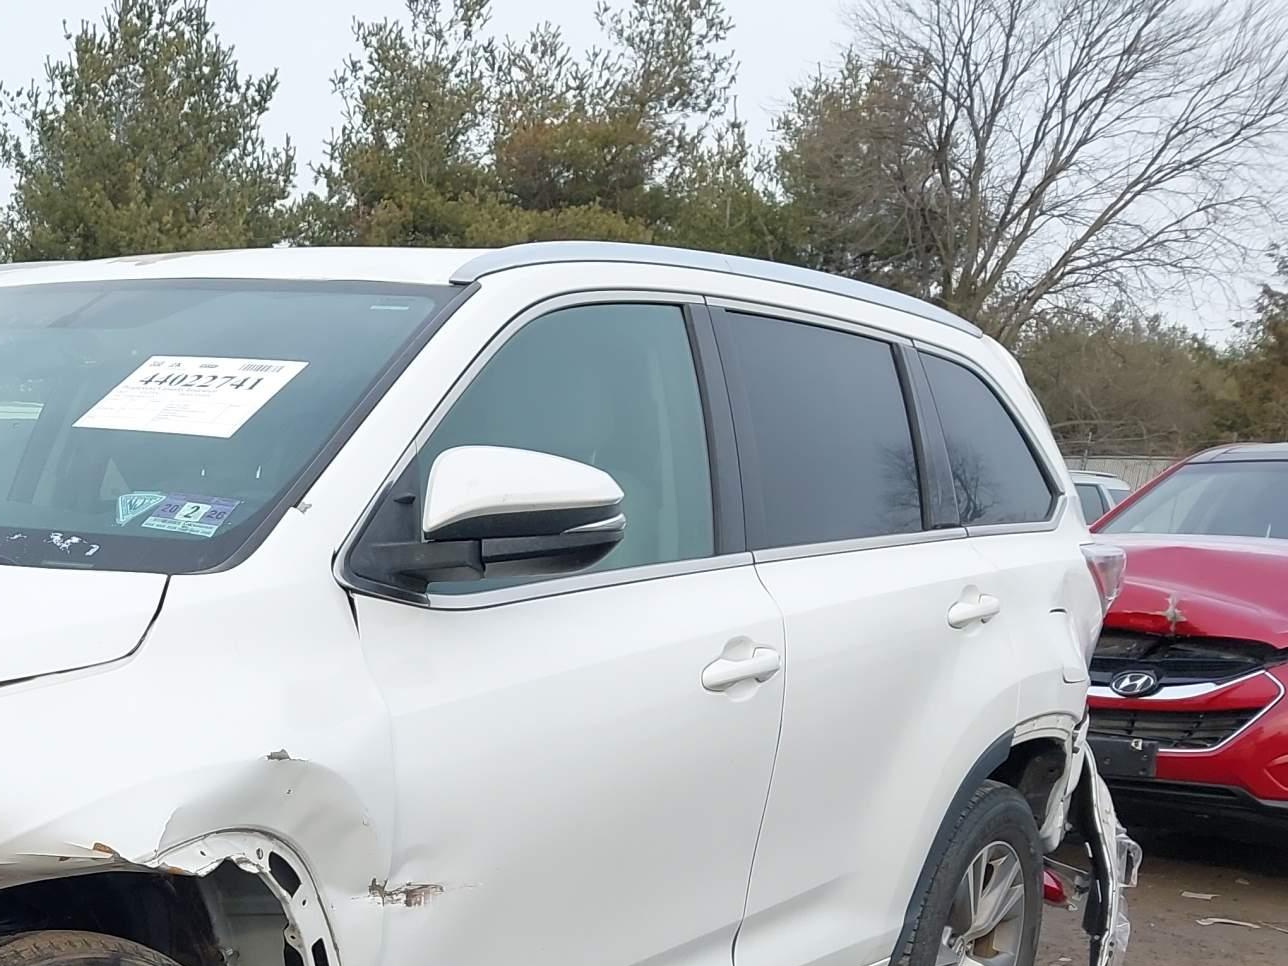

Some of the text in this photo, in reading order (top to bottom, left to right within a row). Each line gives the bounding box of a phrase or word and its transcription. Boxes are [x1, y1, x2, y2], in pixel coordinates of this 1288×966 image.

[139, 372, 264, 391] 44022741
[161, 503, 180, 513] 20
[183, 505, 201, 519] 2
[206, 510, 226, 520] 26
